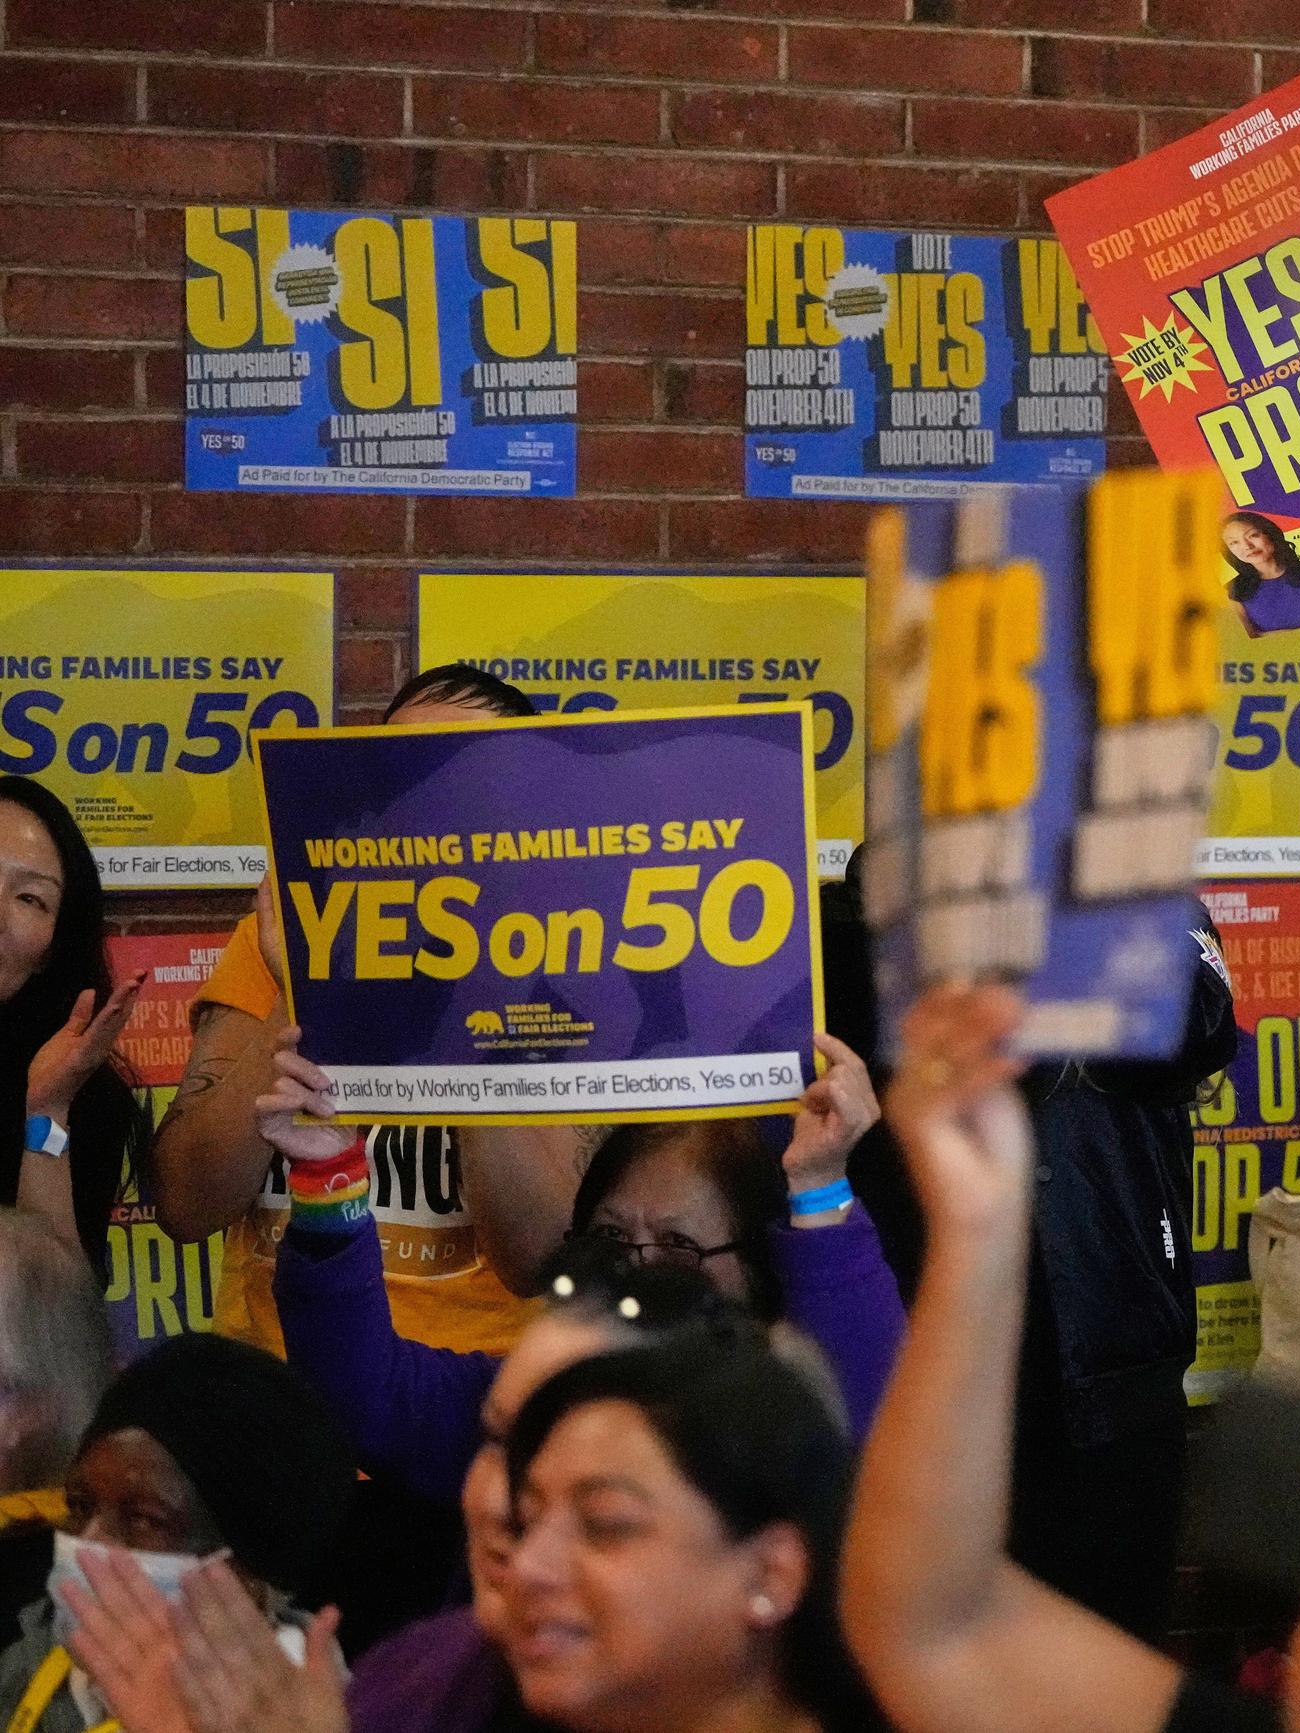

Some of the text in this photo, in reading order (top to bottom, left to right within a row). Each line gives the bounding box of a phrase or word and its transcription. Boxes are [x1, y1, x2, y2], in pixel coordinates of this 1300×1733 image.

[1219, 108, 1275, 148] CALIFORNIA
[1189, 147, 1238, 180] WORKING
[1236, 124, 1284, 161] FAMILIES
[1087, 227, 1137, 269] STOP
[1135, 195, 1221, 249] TRUMP'S
[1221, 157, 1294, 209] AGENDA
[911, 234, 953, 271] VOTE
[1144, 216, 1258, 281] HEALTHCARE
[746, 225, 845, 345] YES
[884, 272, 987, 388] YES
[1126, 325, 1181, 368] VOTE BY
[186, 353, 201, 380] LA
[746, 348, 841, 386] ON PROP 50
[1029, 356, 1097, 393] ON PROP
[1142, 342, 1190, 386] NOV 4TH
[186, 383, 200, 409] EL
[201, 383, 211, 409] 4
[212, 382, 228, 408] DE
[823, 388, 855, 425] 4TH
[890, 391, 981, 427] ON PROP 50
[340, 413, 356, 438] LA
[1017, 396, 1103, 432] NOVEMBER
[201, 433, 245, 450] YES 50
[341, 442, 352, 466] EL
[354, 441, 364, 466] 4
[364, 441, 379, 466] DE
[879, 429, 994, 466] NOVEMBER 4TH
[242, 470, 526, 489] Ad Paid for by The California Democratic Party
[814, 478, 839, 491] Paid
[879, 480, 899, 493] The
[61, 657, 285, 680] FAMILIES SAY
[615, 658, 822, 681] FAMILIES SAY
[66, 722, 170, 775] on
[305, 818, 744, 868] WORKING FAMILIES SAY
[828, 849, 847, 865] 50
[109, 856, 266, 874] for Fair Elections, Yes
[288, 875, 481, 980] YES
[488, 908, 604, 978] on
[613, 858, 796, 973] 50
[1250, 905, 1280, 923] PARTY
[1247, 937, 1265, 964] OF
[153, 965, 201, 983] WORKING
[1270, 970, 1294, 997] ICE
[342, 1066, 798, 1103] paid for by Working Families for Fair Elections, Yes on 50.
